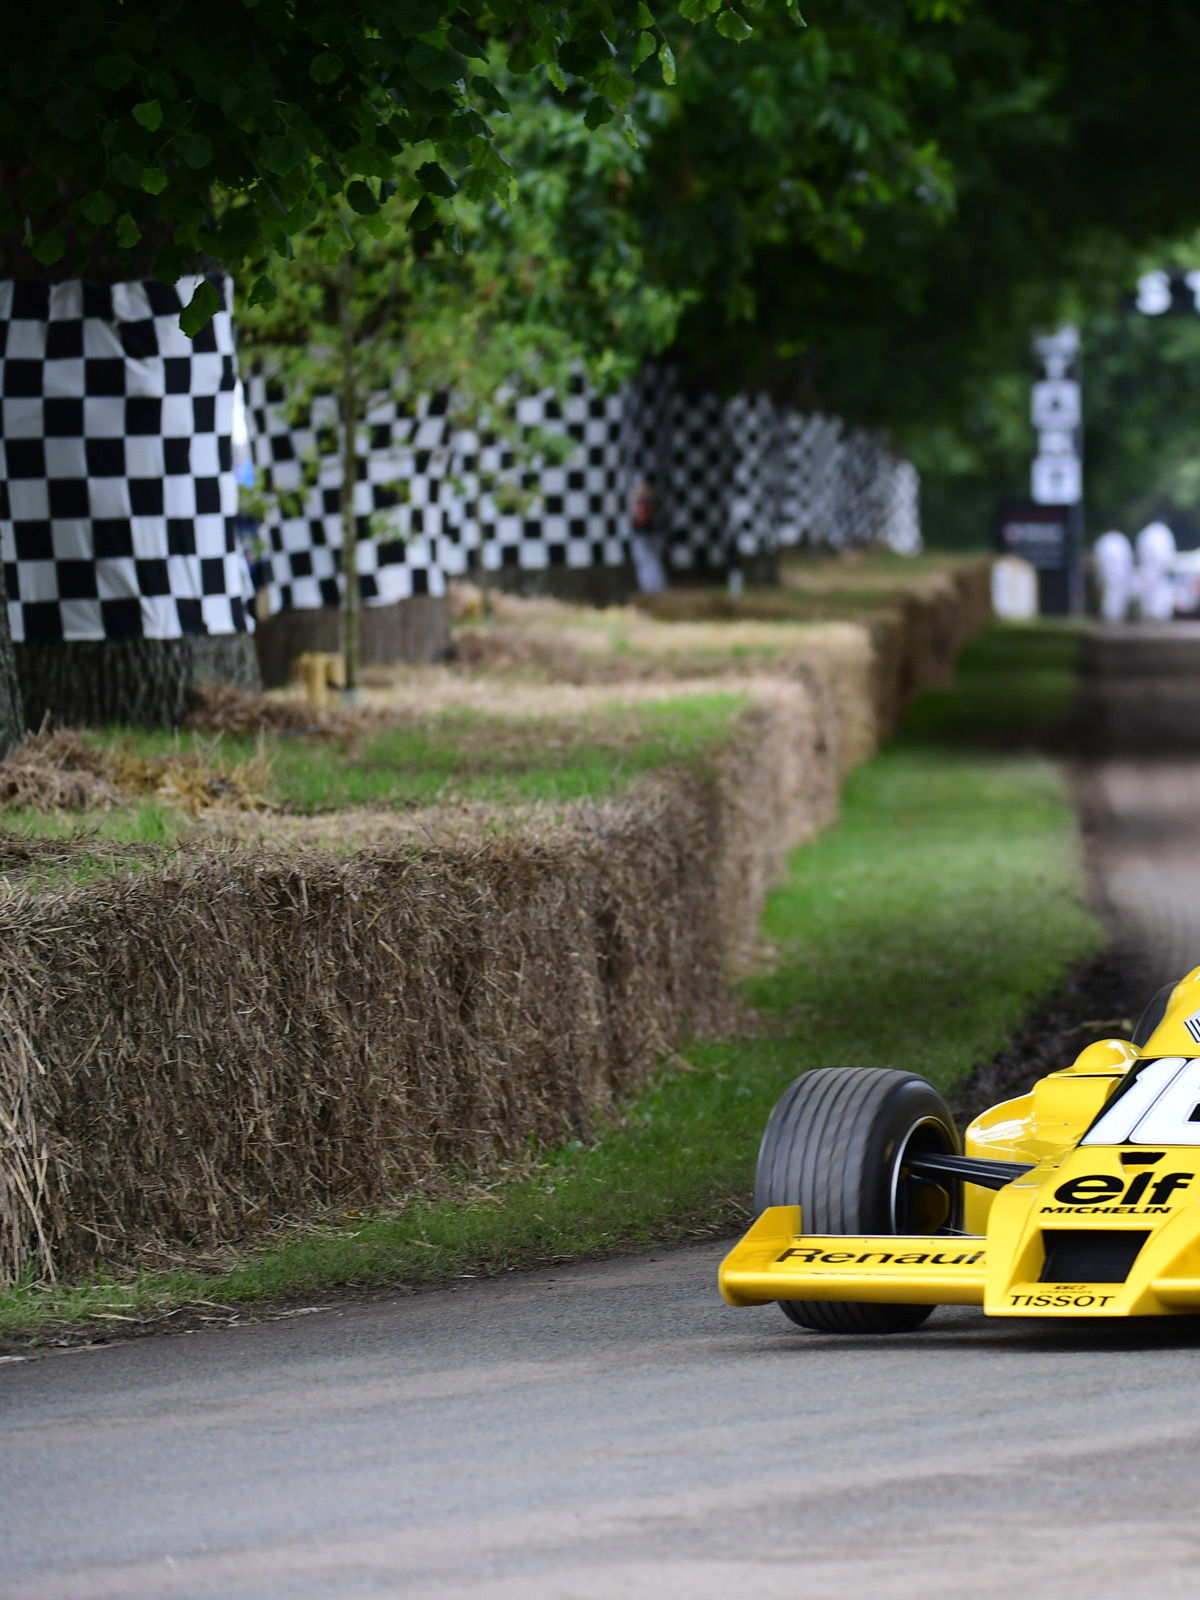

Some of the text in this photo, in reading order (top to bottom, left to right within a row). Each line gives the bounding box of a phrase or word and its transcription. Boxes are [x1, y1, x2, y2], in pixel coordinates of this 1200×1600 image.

[1054, 1171, 1195, 1205] elf
[1039, 1206, 1173, 1214] MICHELIN
[774, 1247, 987, 1265] Renaul
[1010, 1294, 1116, 1307] TISSOT
